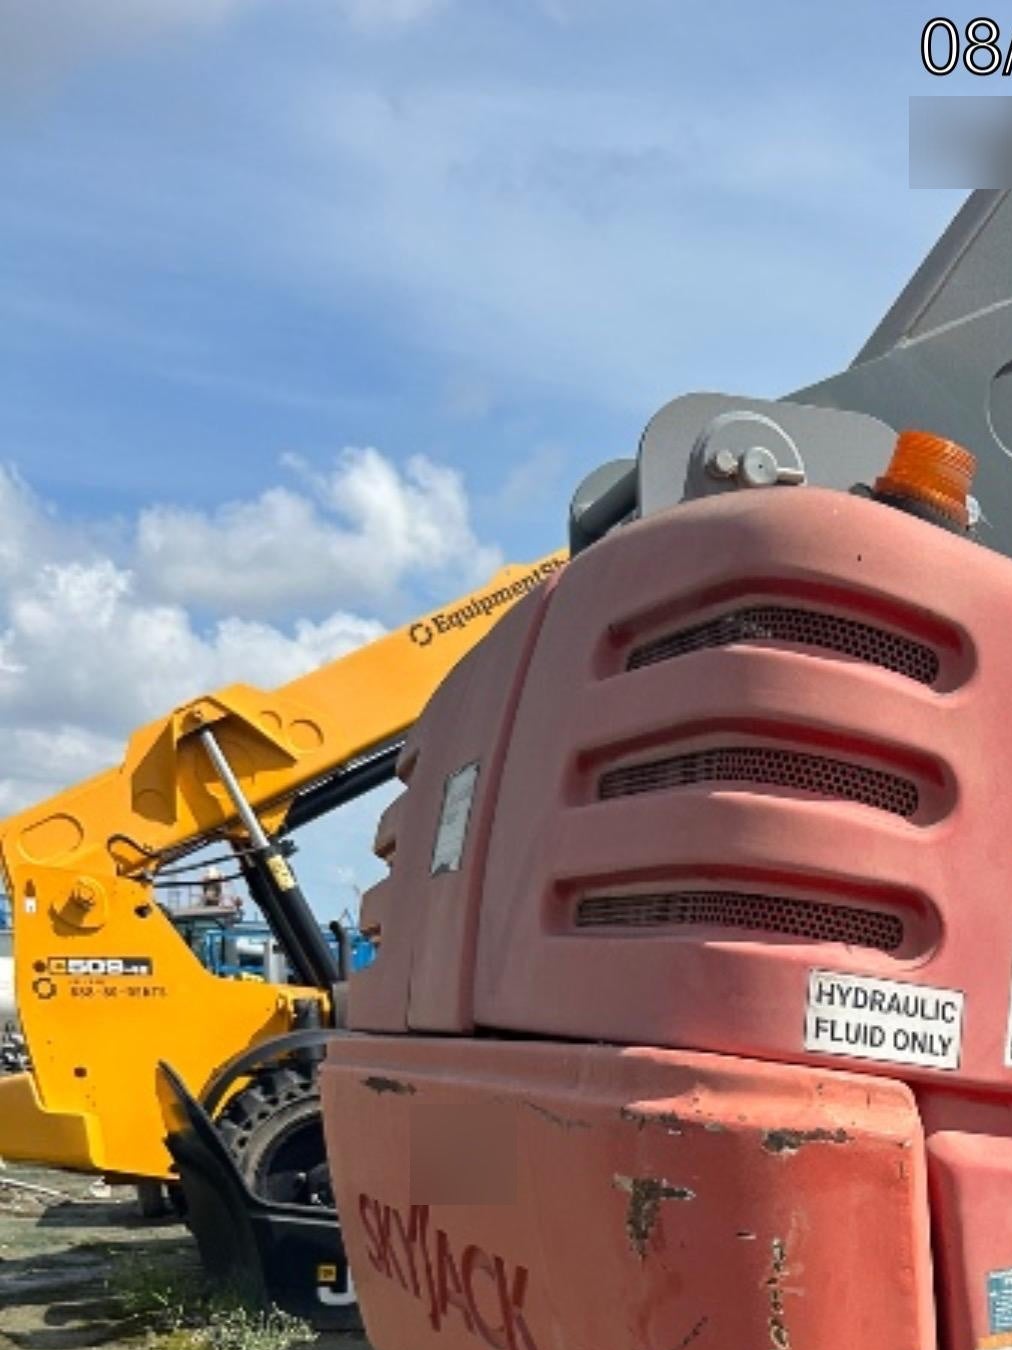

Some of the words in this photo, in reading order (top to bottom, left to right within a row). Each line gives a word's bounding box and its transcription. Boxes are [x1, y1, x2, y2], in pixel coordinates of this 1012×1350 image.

[815, 981, 957, 1024] HYDRAULIC
[814, 1016, 886, 1048] FLUID
[892, 1028, 952, 1057] ONLY
